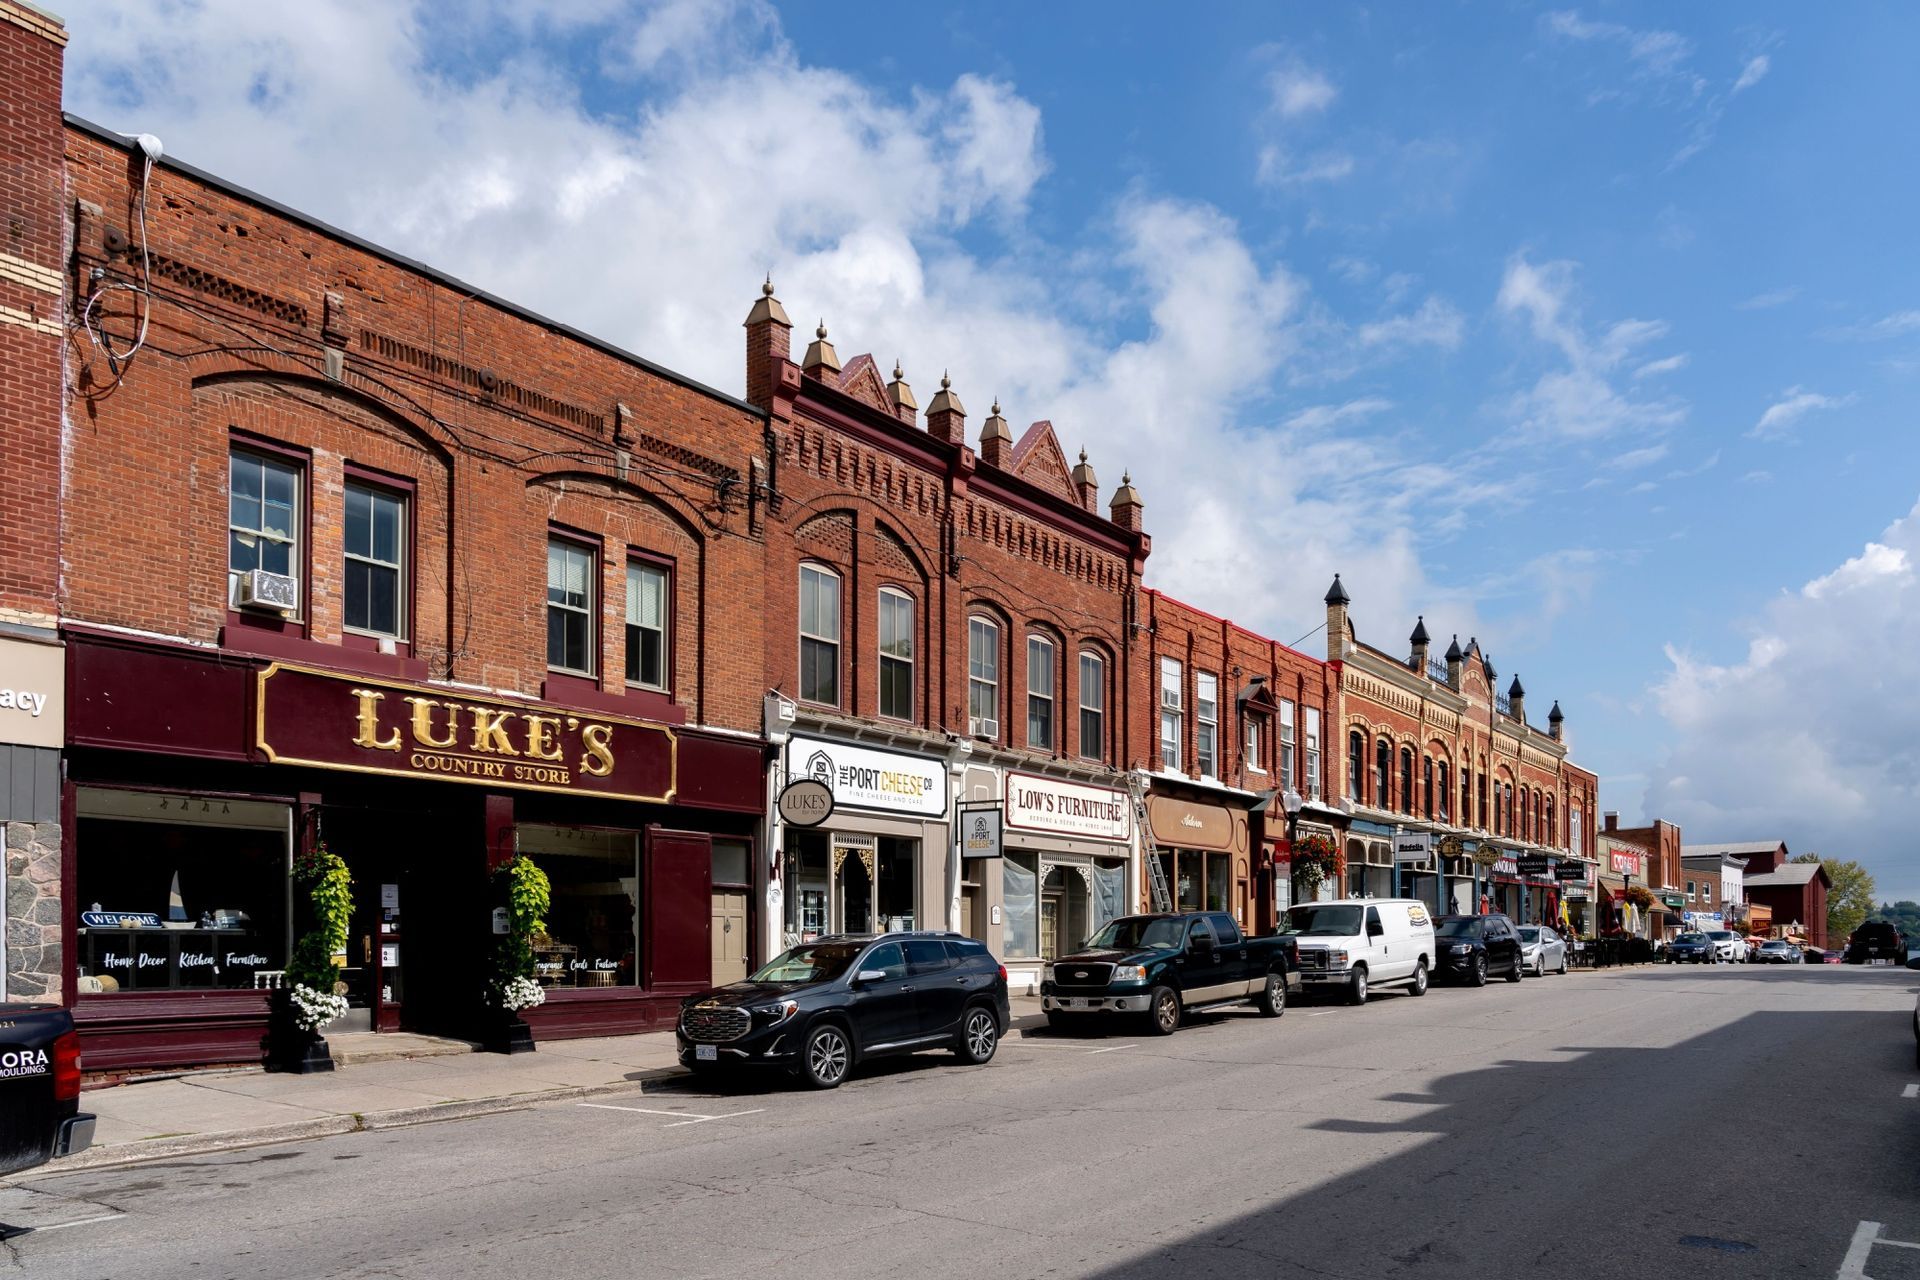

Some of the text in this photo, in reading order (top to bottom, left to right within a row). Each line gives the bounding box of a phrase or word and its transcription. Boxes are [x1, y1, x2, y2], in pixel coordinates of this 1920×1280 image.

[351, 688, 615, 778] LUKE'S
[410, 754, 571, 785] COUNTRY STORE
[839, 764, 849, 787] THE
[850, 766, 881, 791] PORT
[881, 771, 923, 797] CHEESE
[866, 793, 891, 801] CHEESE
[1018, 788, 1122, 822] LOW'S FURNITURE
[967, 840, 990, 849] CHEESE
[975, 831, 990, 840] PORT
[104, 951, 268, 969] Home Decor Kitchen Furniture
